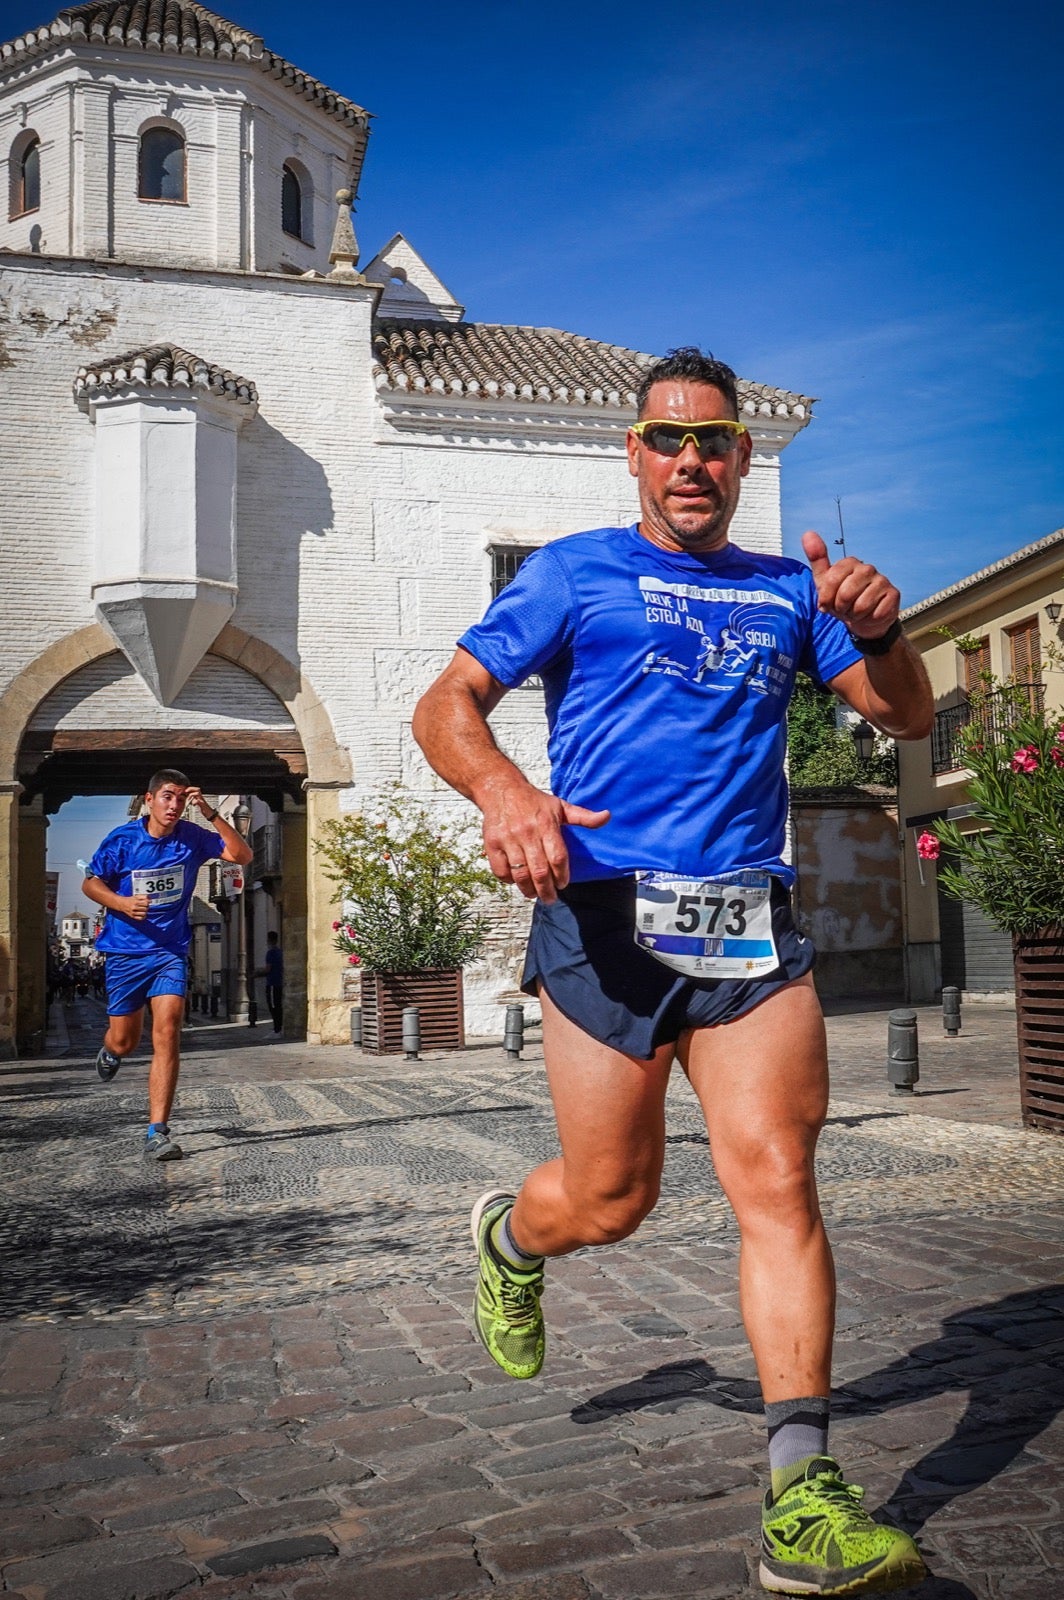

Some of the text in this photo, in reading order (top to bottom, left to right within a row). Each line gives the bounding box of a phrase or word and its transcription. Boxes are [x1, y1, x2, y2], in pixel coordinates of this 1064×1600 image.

[642, 591, 688, 612] VUELVE LA
[647, 608, 707, 635] ESTELA AZUL
[746, 629, 776, 648] SÍGUELA
[146, 878, 174, 892] 365
[675, 895, 746, 935] 573
[704, 939, 724, 956] DAVID
